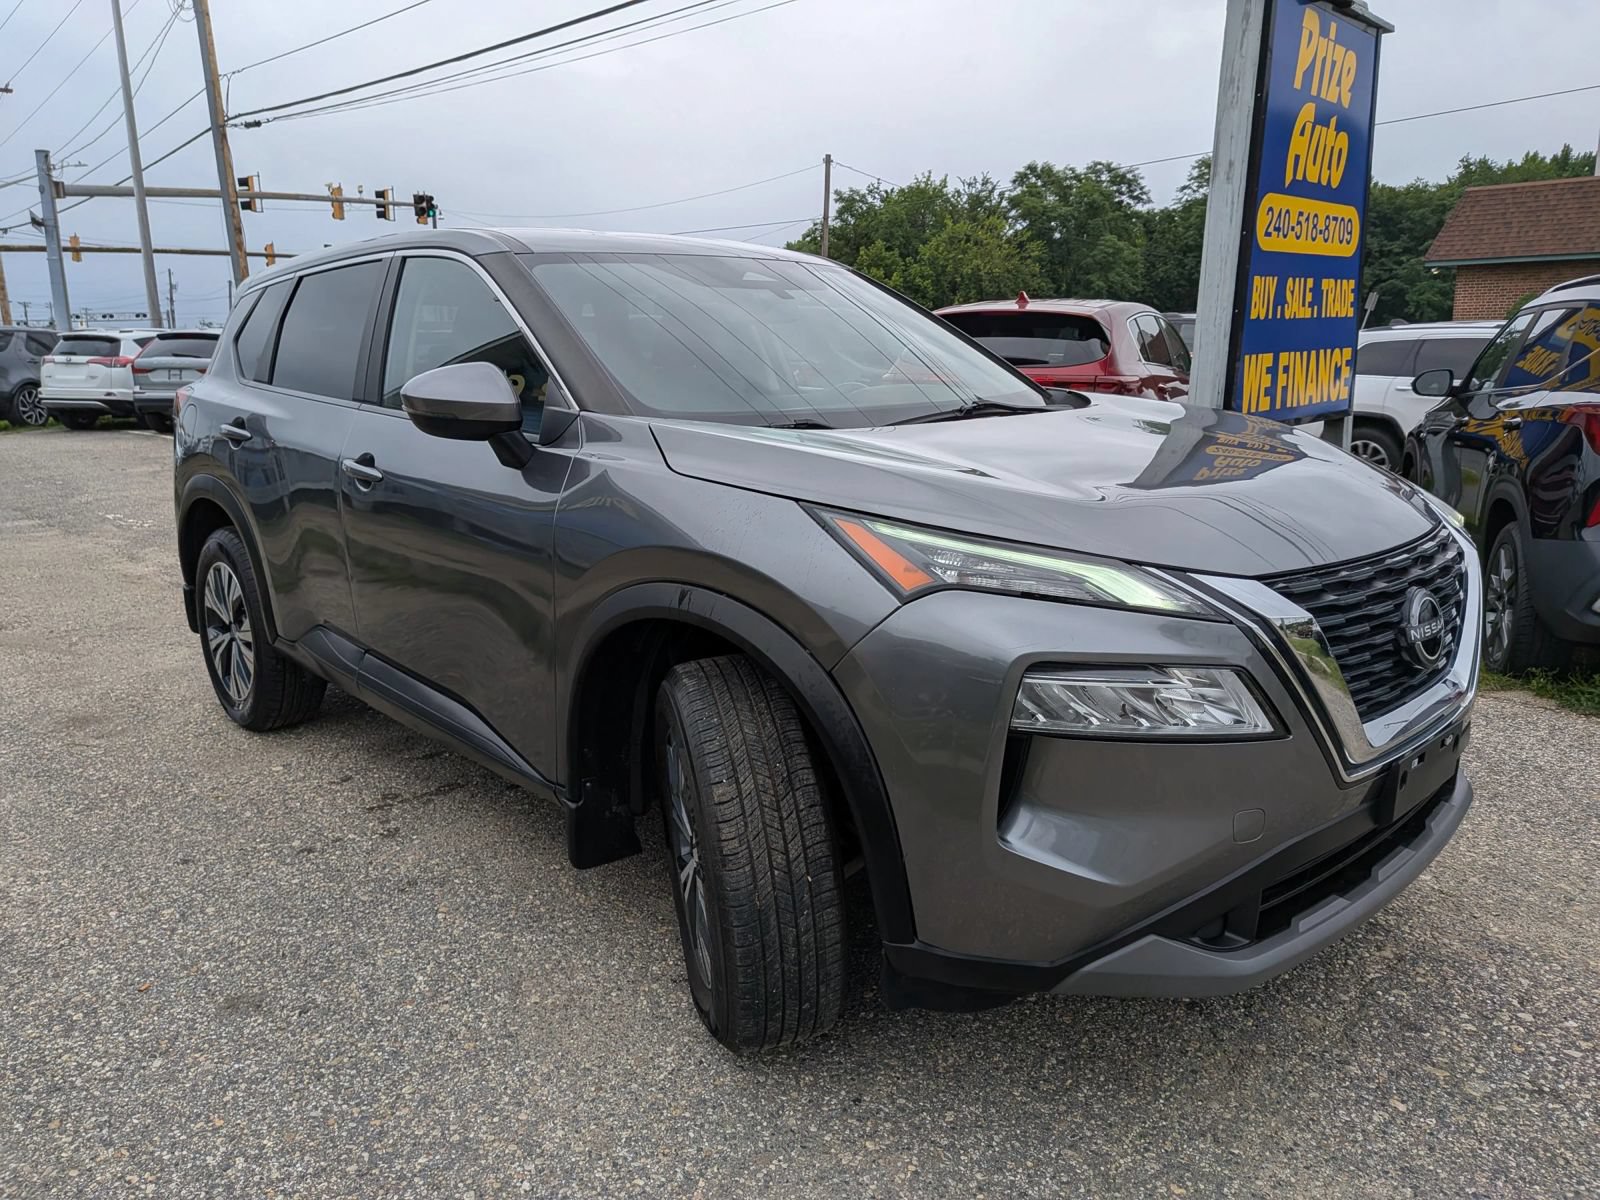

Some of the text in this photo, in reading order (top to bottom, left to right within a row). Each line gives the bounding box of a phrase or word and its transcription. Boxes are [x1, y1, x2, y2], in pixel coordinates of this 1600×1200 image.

[1293, 7, 1357, 108] Prize
[1285, 102, 1349, 189] Auto
[1264, 206, 1353, 246] 240-518-8709
[1321, 278, 1355, 318] TRADE
[1242, 347, 1352, 414] WE FINANCE
